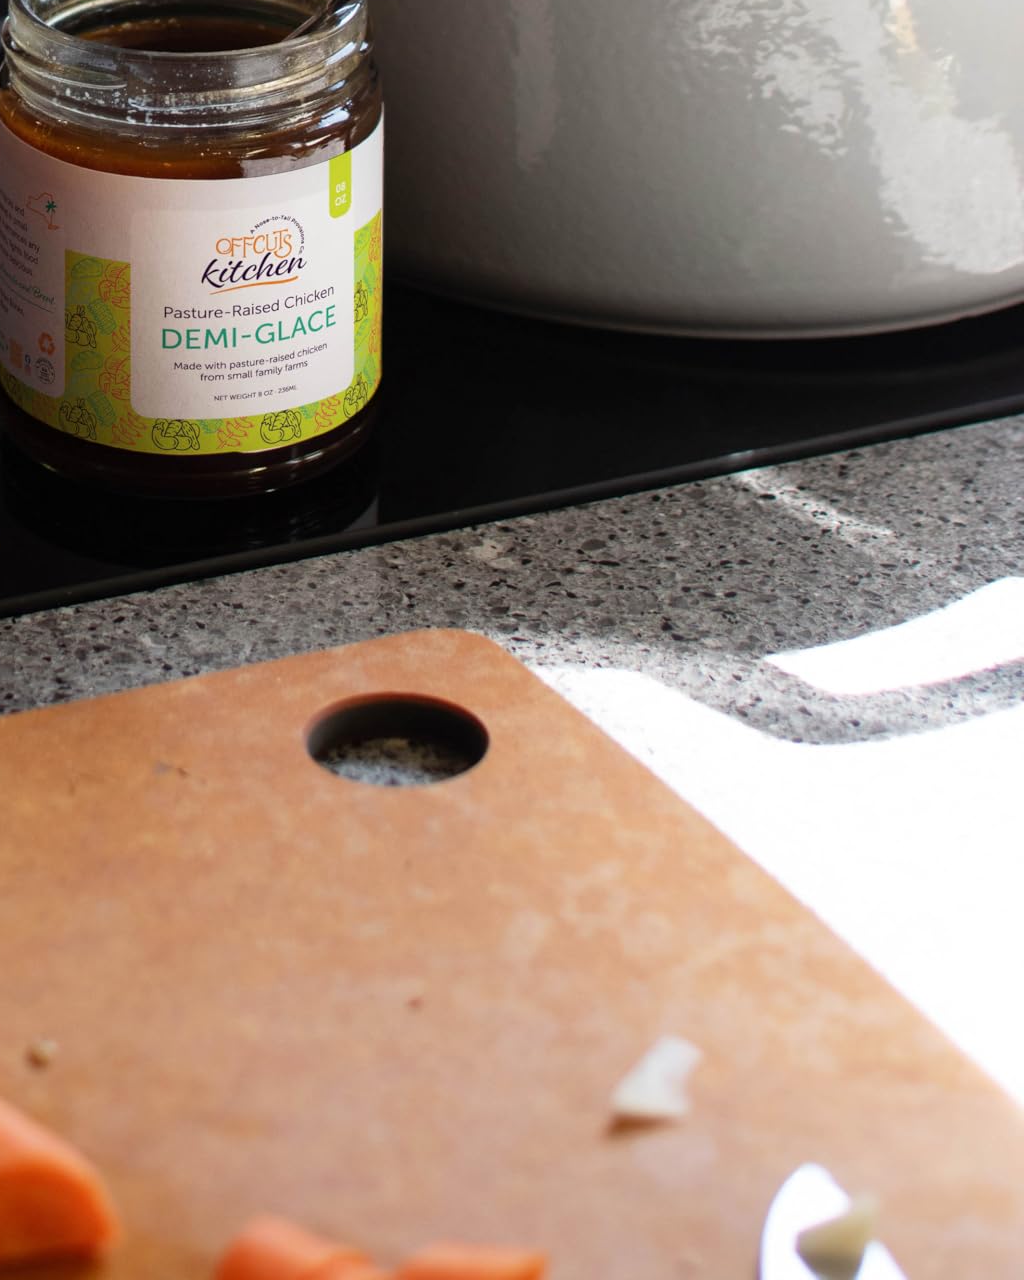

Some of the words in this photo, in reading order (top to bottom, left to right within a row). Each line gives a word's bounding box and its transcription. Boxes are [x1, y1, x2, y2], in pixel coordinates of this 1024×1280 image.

[335, 193, 347, 206] OZ
[215, 228, 292, 259] OFFCUTS
[254, 214, 291, 229] Nose-to-Tail
[291, 218, 305, 245] Provisions
[201, 252, 307, 288] kitchen
[163, 300, 280, 319] Pasture-Raised
[284, 285, 335, 309] Chicken
[161, 304, 337, 350] DEMI-GLACE
[173, 361, 202, 371] Made
[204, 361, 227, 371] with
[229, 349, 296, 372] pasture-raised
[297, 342, 328, 359] chicken
[200, 373, 225, 383] from
[227, 371, 253, 381] small
[255, 365, 283, 379] family
[284, 360, 309, 372] farms
[214, 394, 227, 402] NET
[229, 391, 257, 401] WEIGHT
[263, 389, 275, 397] OZ
